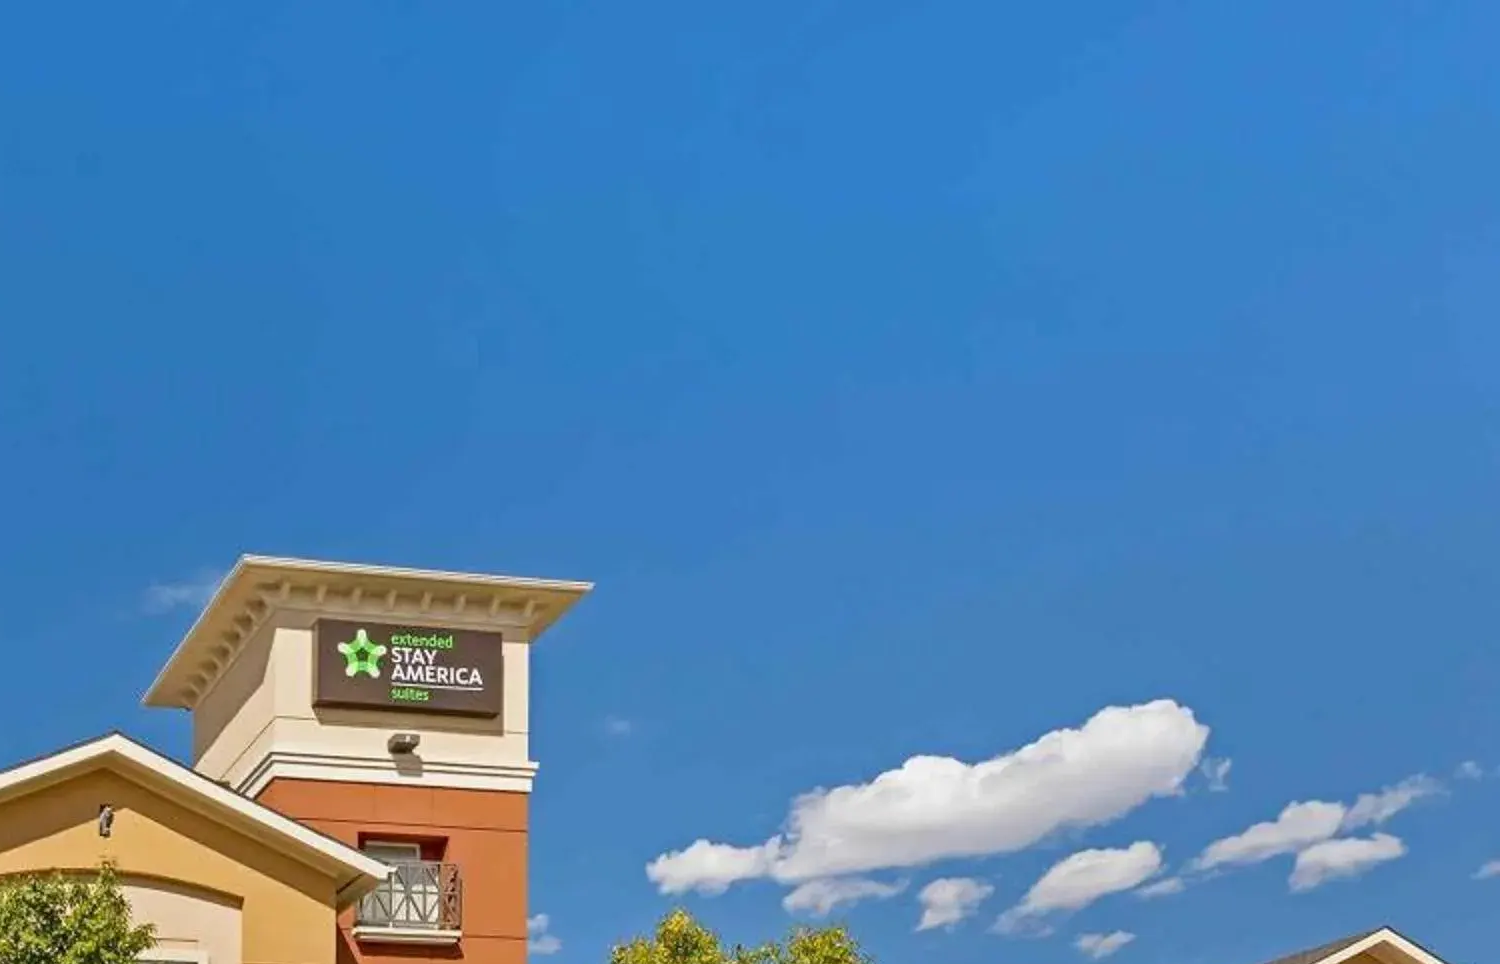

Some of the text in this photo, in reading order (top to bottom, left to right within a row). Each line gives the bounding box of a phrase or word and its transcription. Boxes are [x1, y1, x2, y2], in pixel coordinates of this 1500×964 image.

[391, 634, 453, 648] extended
[391, 647, 437, 665] STAY
[391, 664, 483, 685] AMERICA
[391, 687, 429, 701] suites
